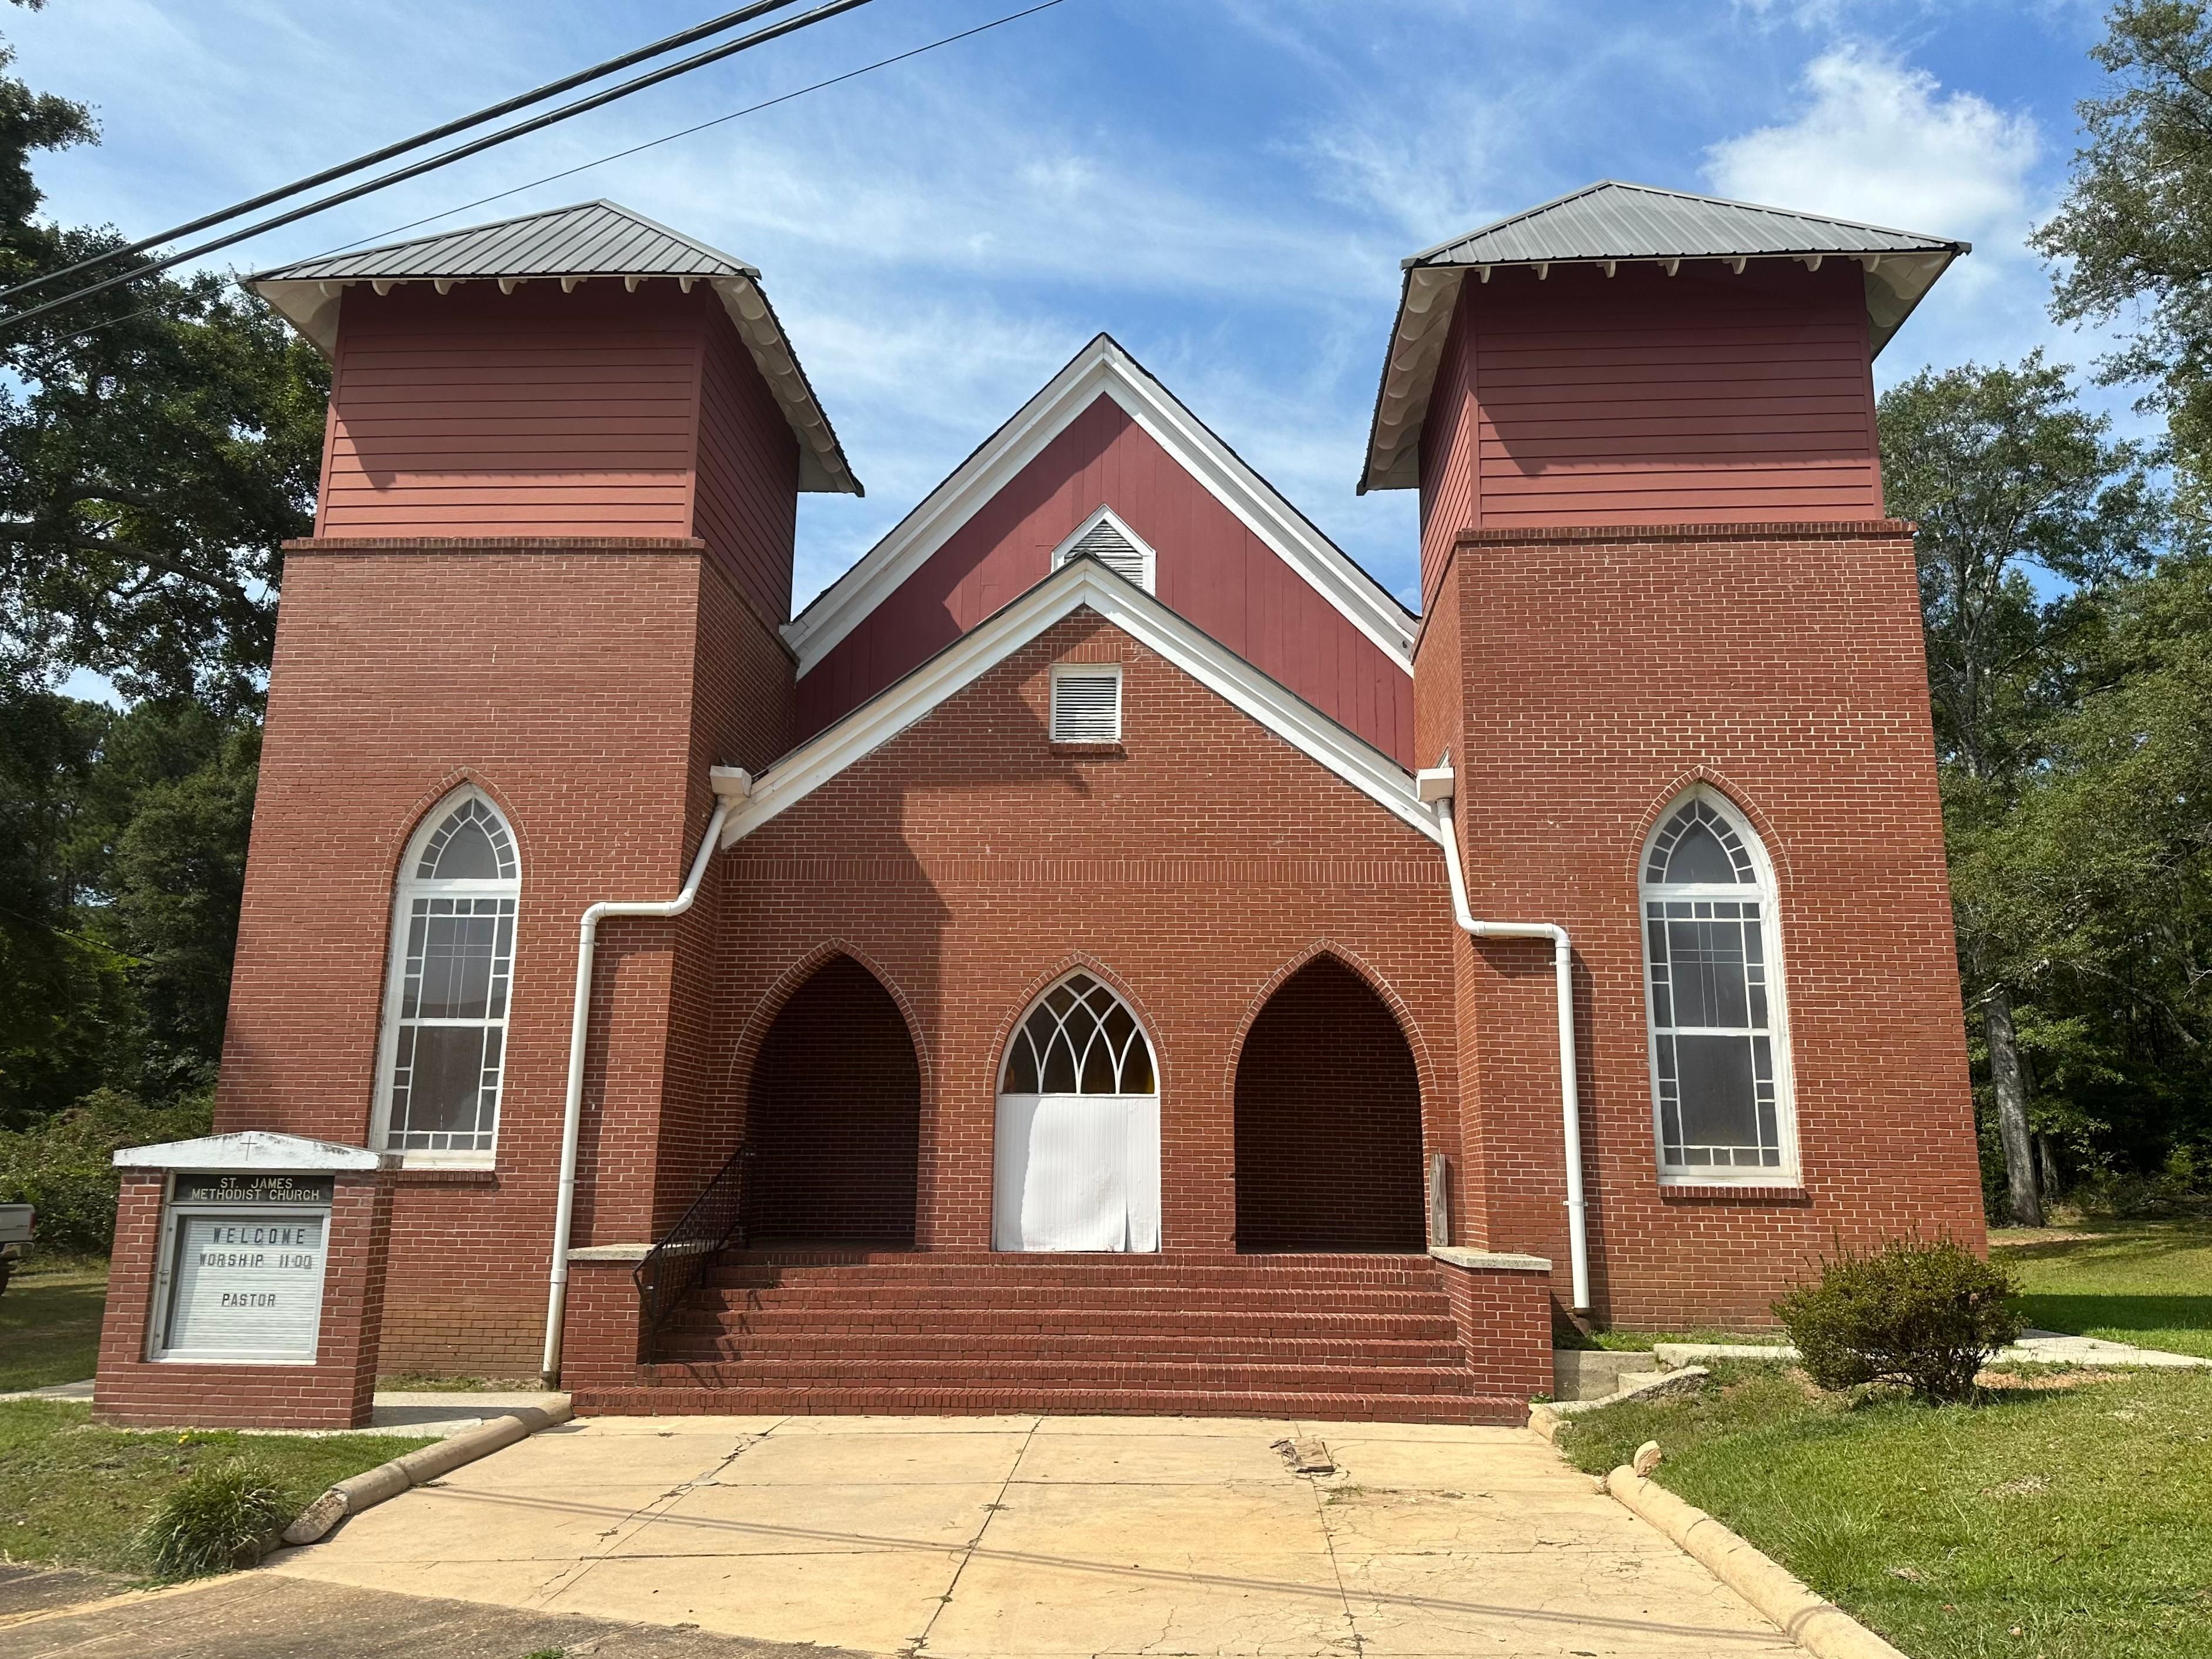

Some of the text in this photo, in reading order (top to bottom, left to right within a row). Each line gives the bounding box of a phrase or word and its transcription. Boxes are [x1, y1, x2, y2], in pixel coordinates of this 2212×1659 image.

[220, 1177, 293, 1189] ST. JAMES
[191, 1189, 320, 1200] METHODIST CHURCH
[213, 1227, 305, 1244] WELCOME
[199, 1253, 312, 1269] WORSHIP 11:00
[221, 1293, 276, 1307] PASTOR
